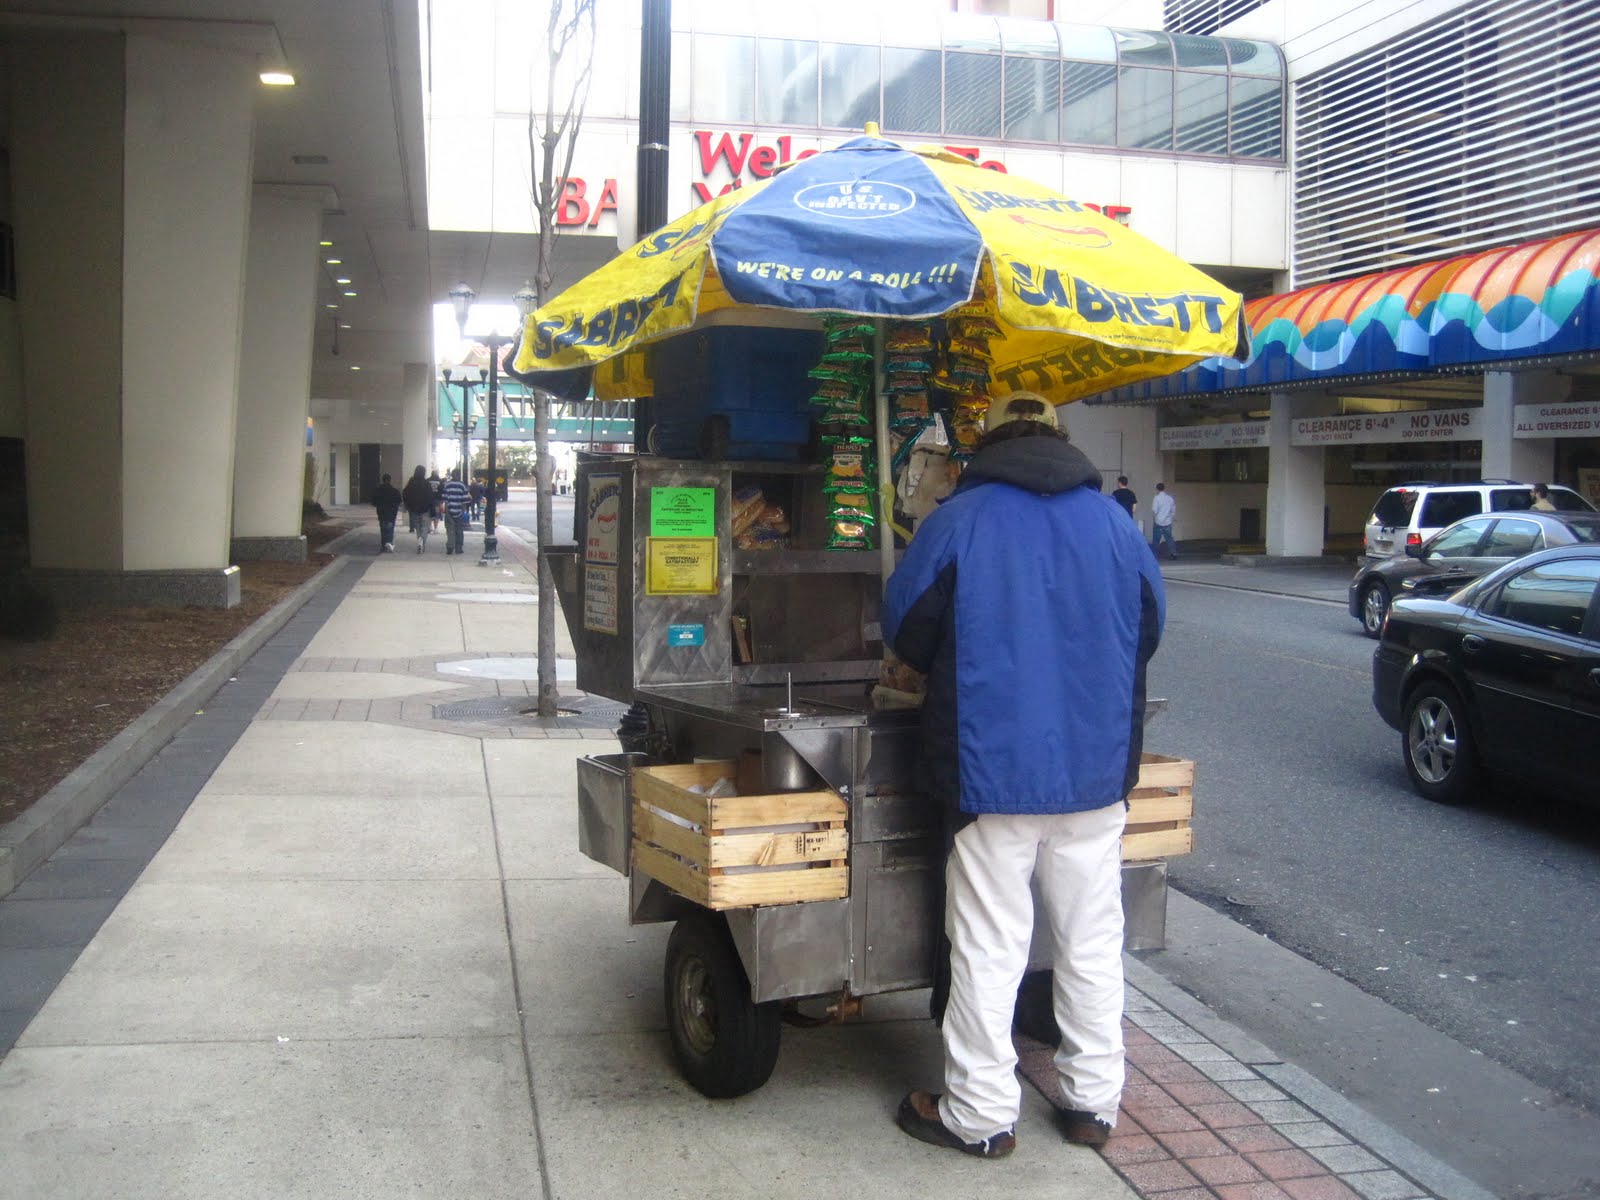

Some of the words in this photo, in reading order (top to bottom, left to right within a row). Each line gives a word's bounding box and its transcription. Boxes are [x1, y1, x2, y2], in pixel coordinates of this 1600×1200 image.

[555, 176, 617, 227] BA
[808, 200, 900, 211] INSPECTED
[955, 186, 1084, 213] SABRETT
[736, 260, 804, 281] WE'RE
[811, 267, 843, 281] ON
[848, 270, 862, 280] A
[869, 271, 922, 289] ROLL
[1009, 261, 1226, 334] SABRETT
[1540, 406, 1590, 417] CLEARANCE
[1298, 418, 1362, 434] CLEARANCE
[1365, 417, 1395, 431] 6'-4"
[1410, 415, 1430, 428] NO
[1434, 412, 1470, 427] VANS
[1516, 423, 1534, 432] ALL
[1536, 420, 1591, 431] OVERSIZED
[1232, 427, 1242, 436] NO
[1245, 425, 1266, 435] VANS
[1402, 429, 1413, 438] DO
[1414, 429, 1428, 438] NOT
[1430, 428, 1454, 437] ENTER
[1334, 433, 1353, 441] ENTER
